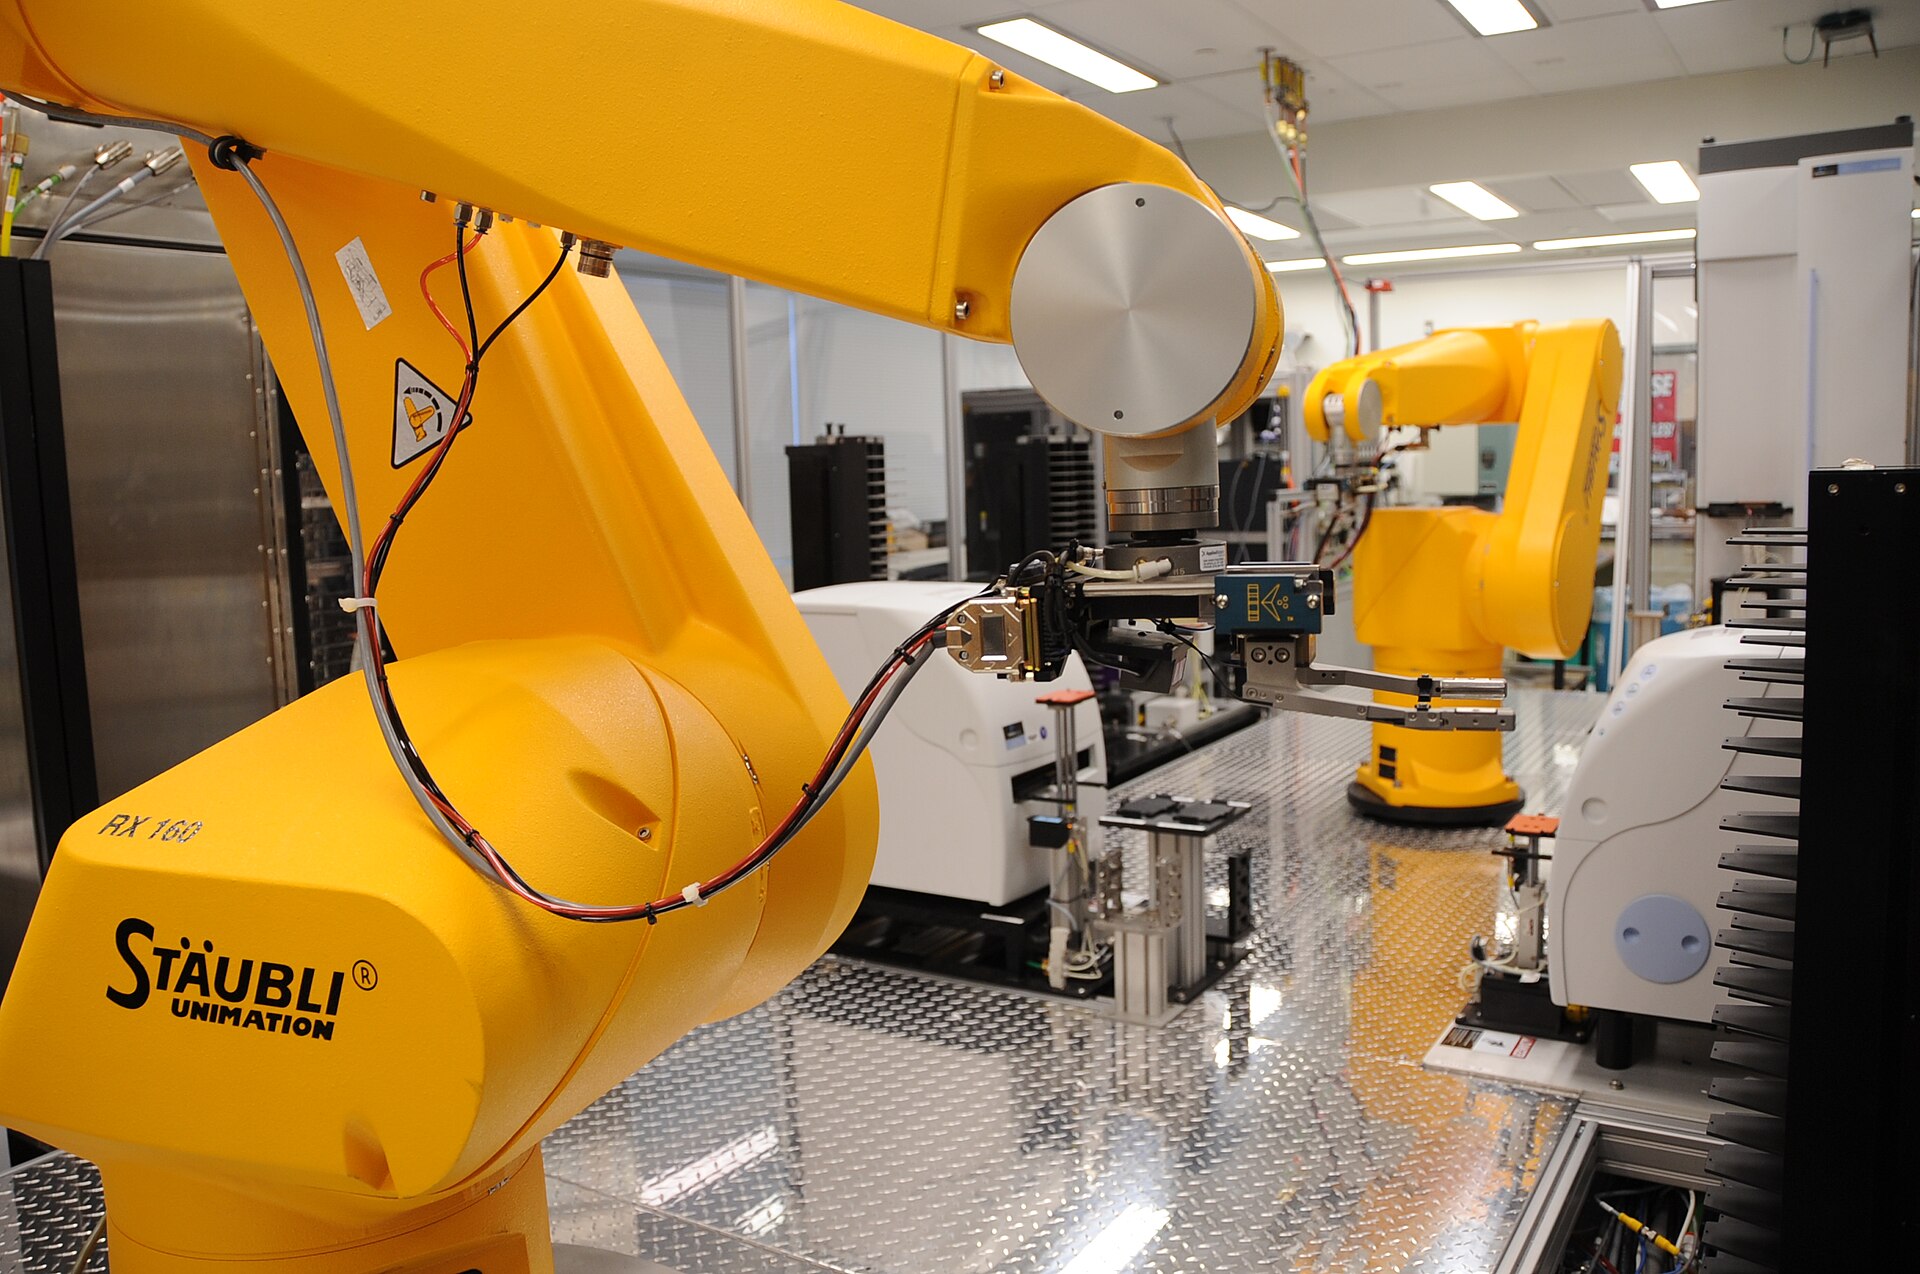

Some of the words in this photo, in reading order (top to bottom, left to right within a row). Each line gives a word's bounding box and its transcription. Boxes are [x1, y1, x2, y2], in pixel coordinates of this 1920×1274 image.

[97, 813, 152, 838] RX
[147, 818, 203, 844] 160
[105, 917, 345, 1016] STÄUBLI
[170, 997, 336, 1041] UNIMATION
